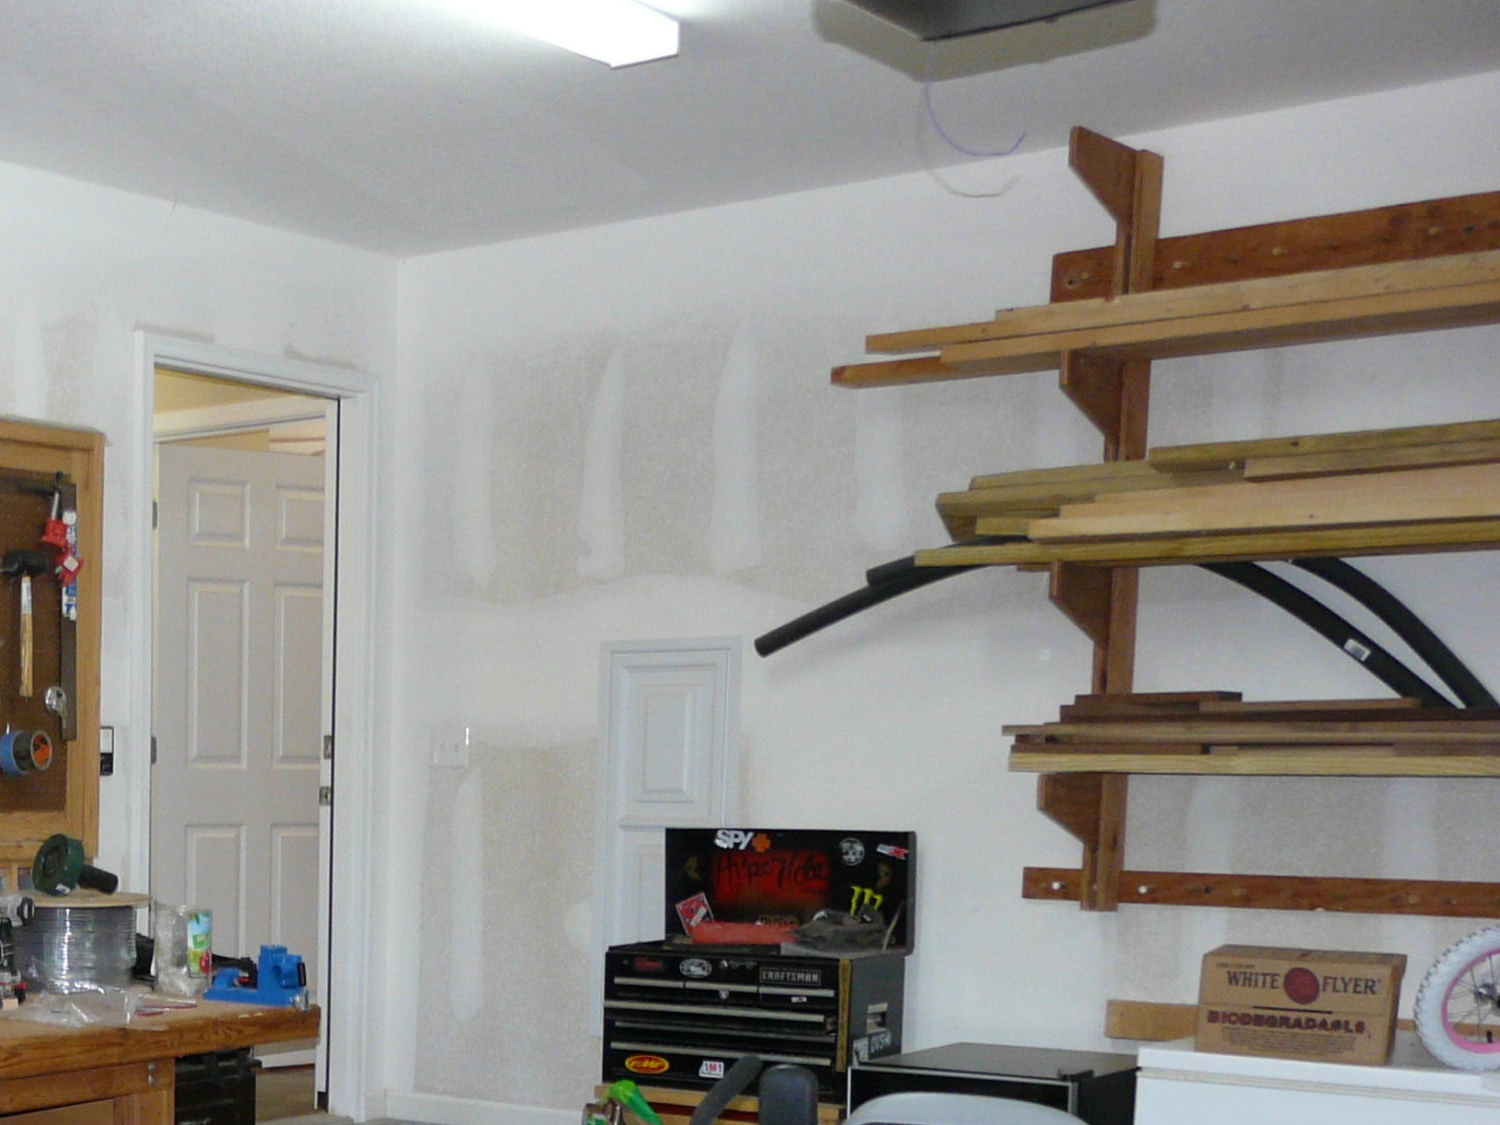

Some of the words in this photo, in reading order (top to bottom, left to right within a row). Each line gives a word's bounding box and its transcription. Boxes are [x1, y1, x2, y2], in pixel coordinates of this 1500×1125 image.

[714, 829, 754, 850] SPY
[762, 970, 819, 983] CRAFTSMAN
[1226, 970, 1281, 990] WHITE
[1321, 975, 1377, 995] FLYER
